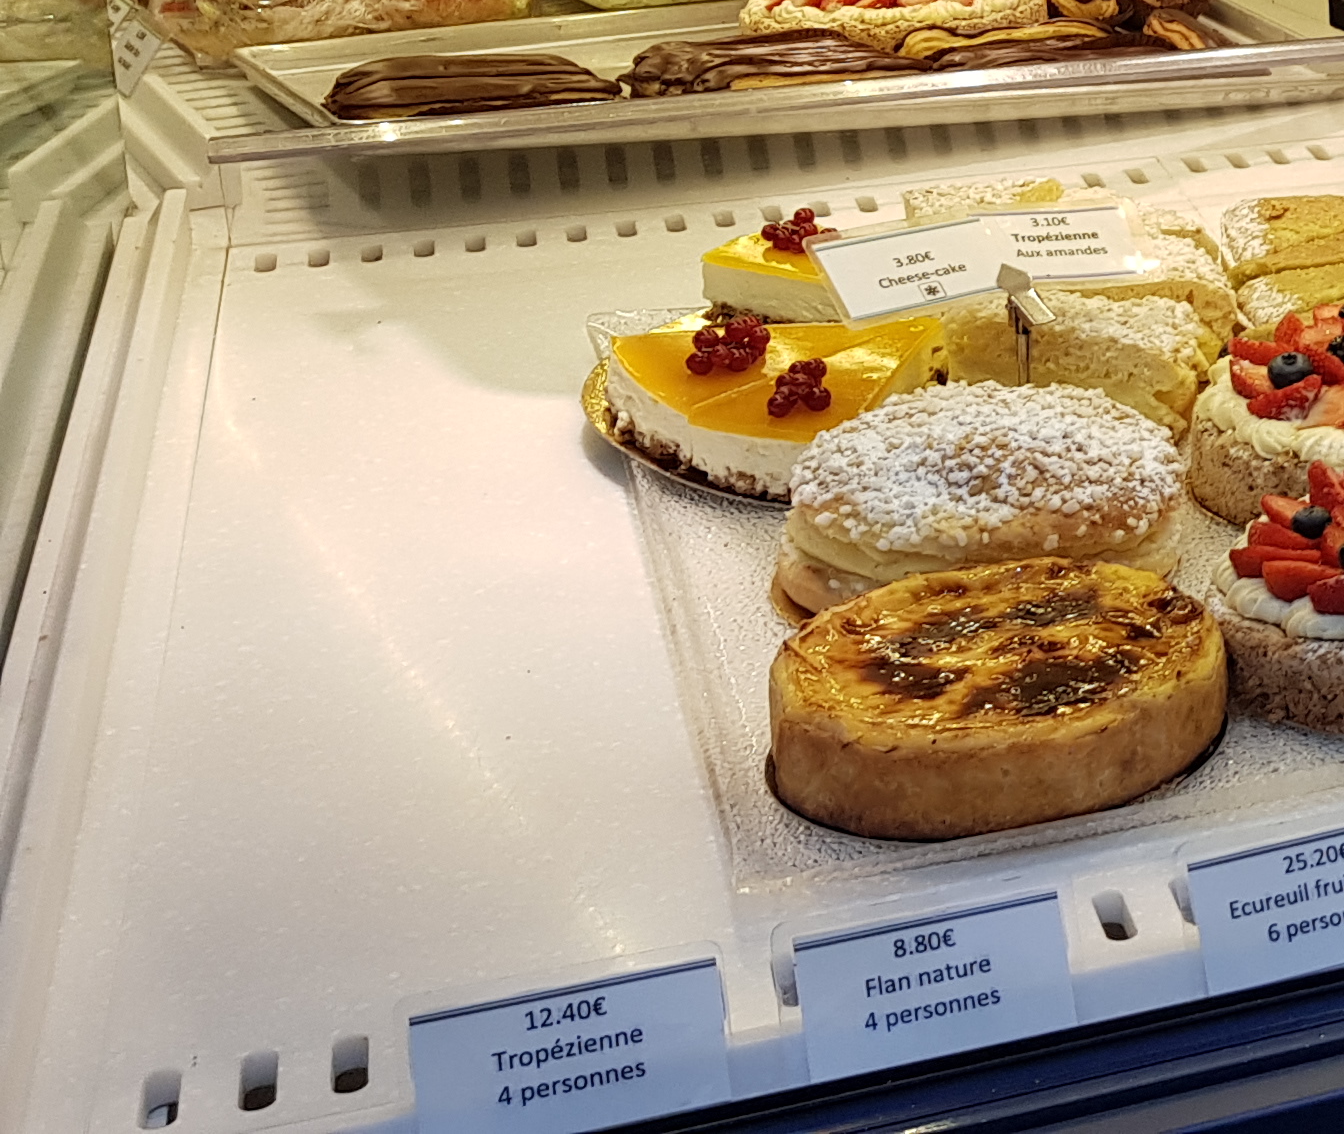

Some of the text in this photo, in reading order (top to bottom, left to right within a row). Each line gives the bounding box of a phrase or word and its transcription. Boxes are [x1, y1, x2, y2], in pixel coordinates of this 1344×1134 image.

[1010, 229, 1100, 245] Tropézienne
[1030, 215, 1071, 229] 3.10€
[892, 250, 936, 269] 3.80€
[1016, 244, 1109, 259] Aux amandes
[878, 260, 968, 290] Cheese-cake
[1229, 882, 1309, 920] Ecureuil
[893, 928, 956, 958] 8.80€
[1267, 923, 1281, 942] 6
[865, 957, 992, 998] Flan nature
[525, 996, 607, 1031] 12.40€
[864, 989, 1002, 1032] 4 personnes
[491, 1027, 644, 1072] Tropézienne
[498, 1061, 647, 1107] 4 personnes
